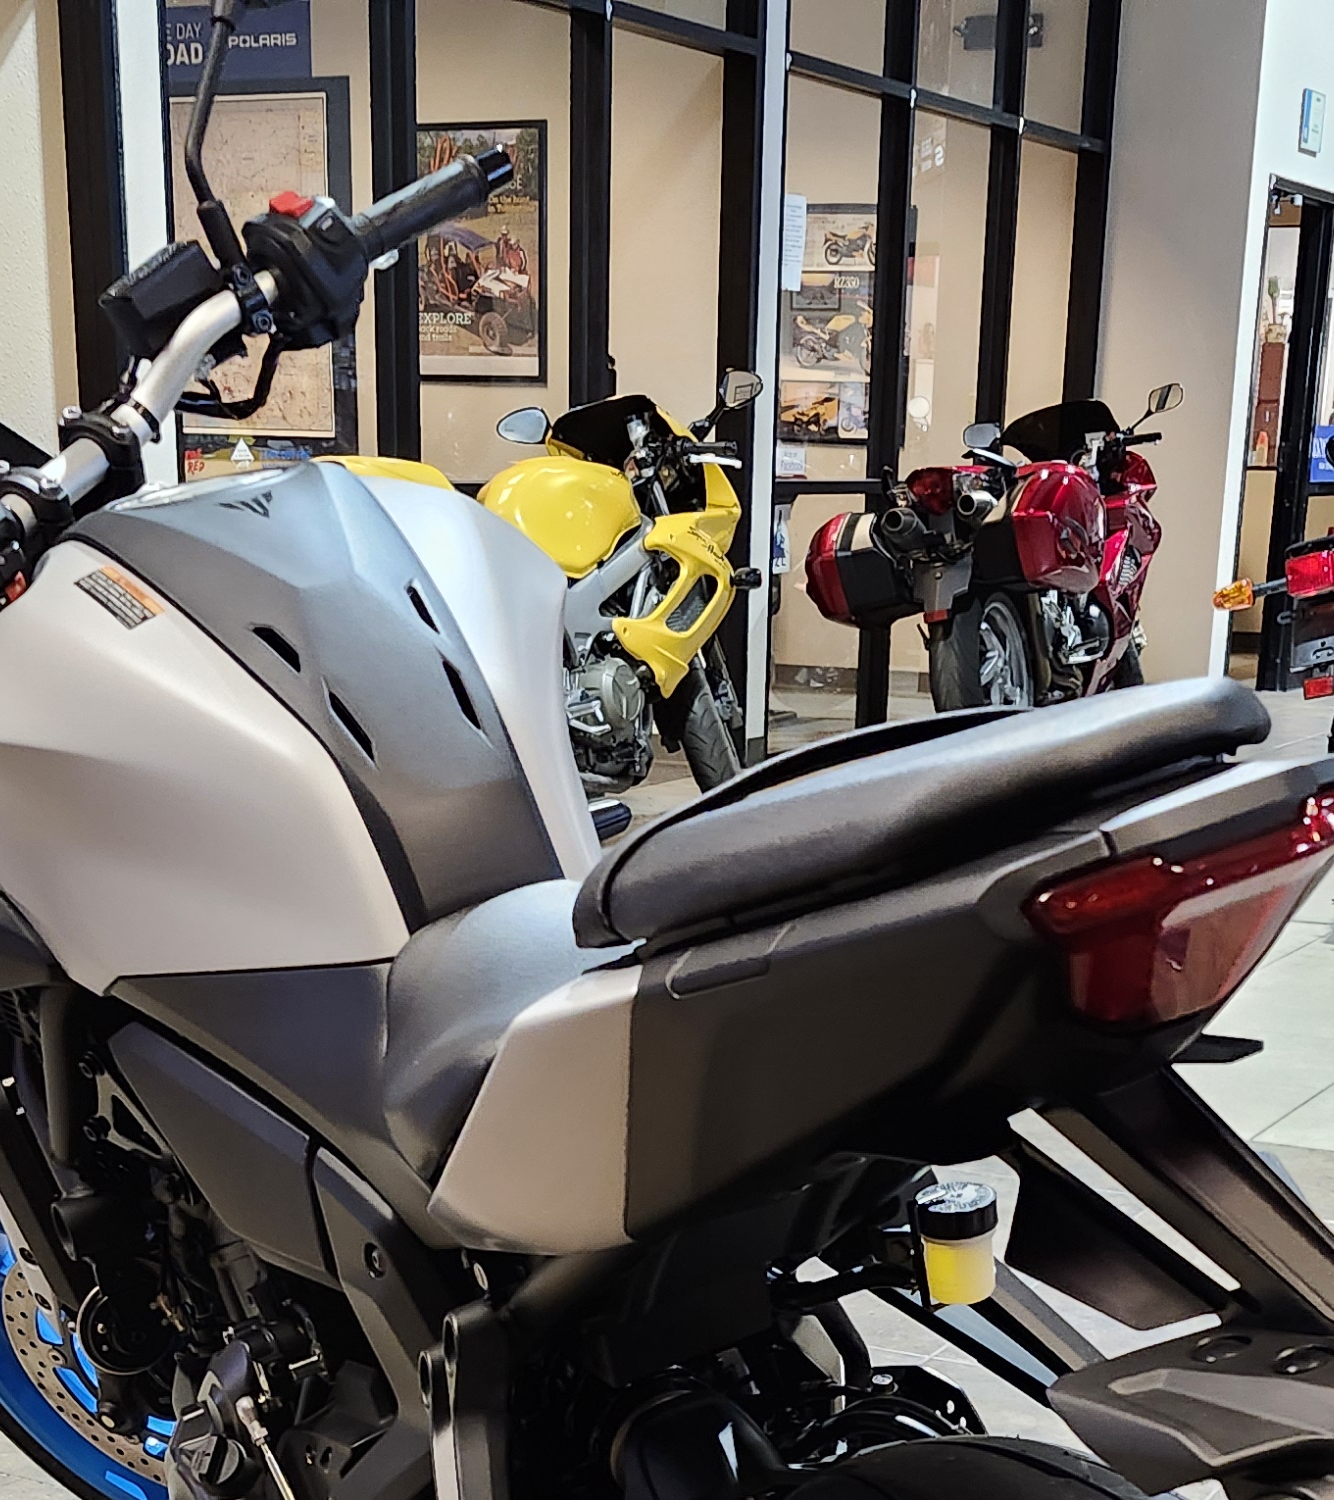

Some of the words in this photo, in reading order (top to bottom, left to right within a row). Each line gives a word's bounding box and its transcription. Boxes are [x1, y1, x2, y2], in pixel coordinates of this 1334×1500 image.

[176, 23, 202, 39] DAY
[228, 33, 297, 49] POLARIS
[833, 276, 860, 290] RZ350
[186, 460, 206, 476] RED
